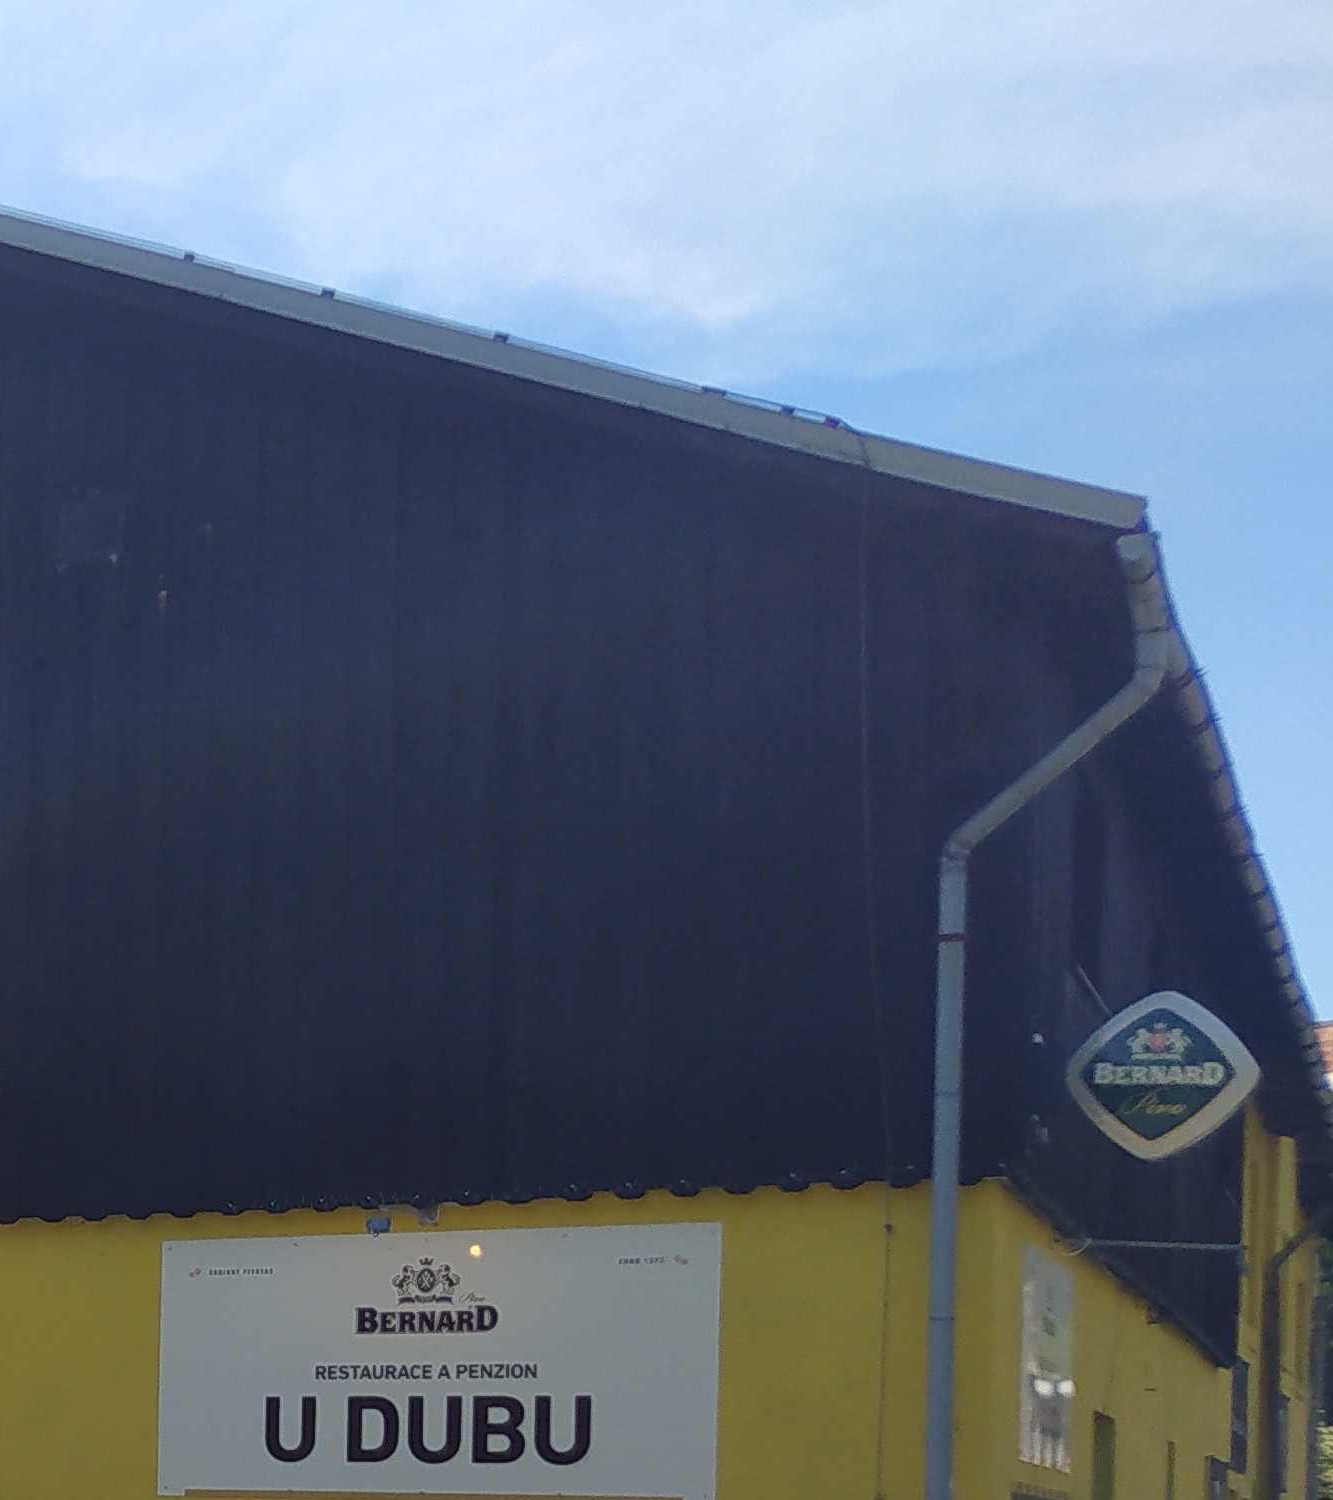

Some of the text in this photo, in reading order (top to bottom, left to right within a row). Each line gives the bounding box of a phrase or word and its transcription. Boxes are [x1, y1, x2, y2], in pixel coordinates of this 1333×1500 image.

[1093, 1061, 1225, 1086] BERNARD
[354, 1305, 499, 1335] BERNARD
[314, 1363, 539, 1380] RESTAURACE A PENZION
[264, 1394, 592, 1466] U DUBU
